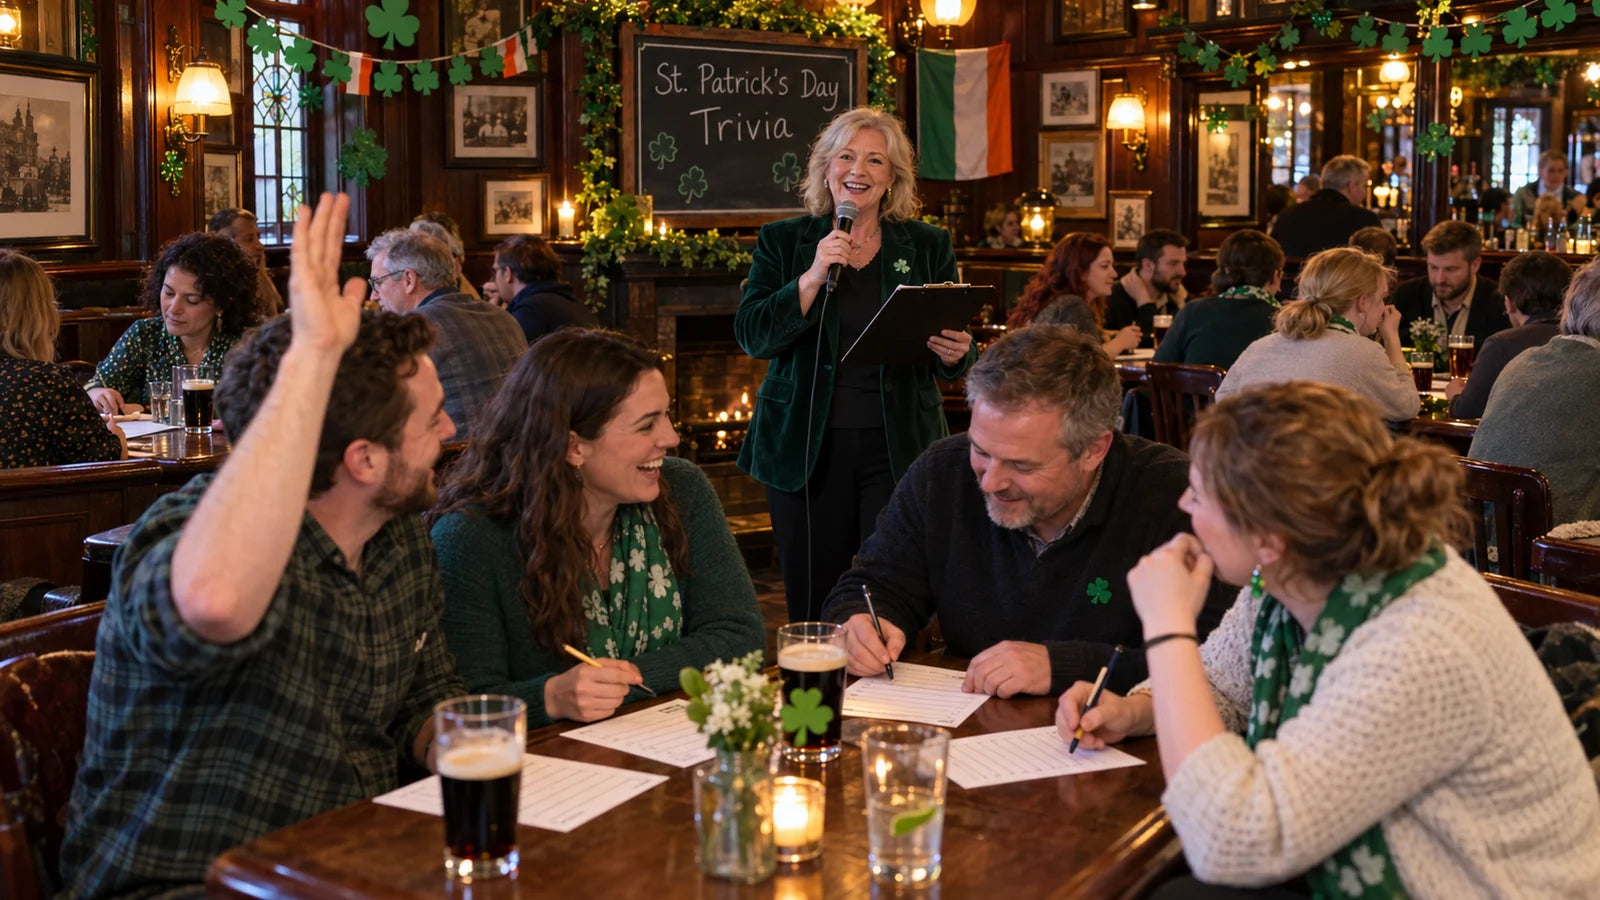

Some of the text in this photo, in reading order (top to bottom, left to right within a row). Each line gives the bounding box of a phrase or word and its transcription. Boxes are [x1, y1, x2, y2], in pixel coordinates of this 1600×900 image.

[655, 62, 839, 112] St. Patrick's Day
[689, 106, 794, 145] Trivia
